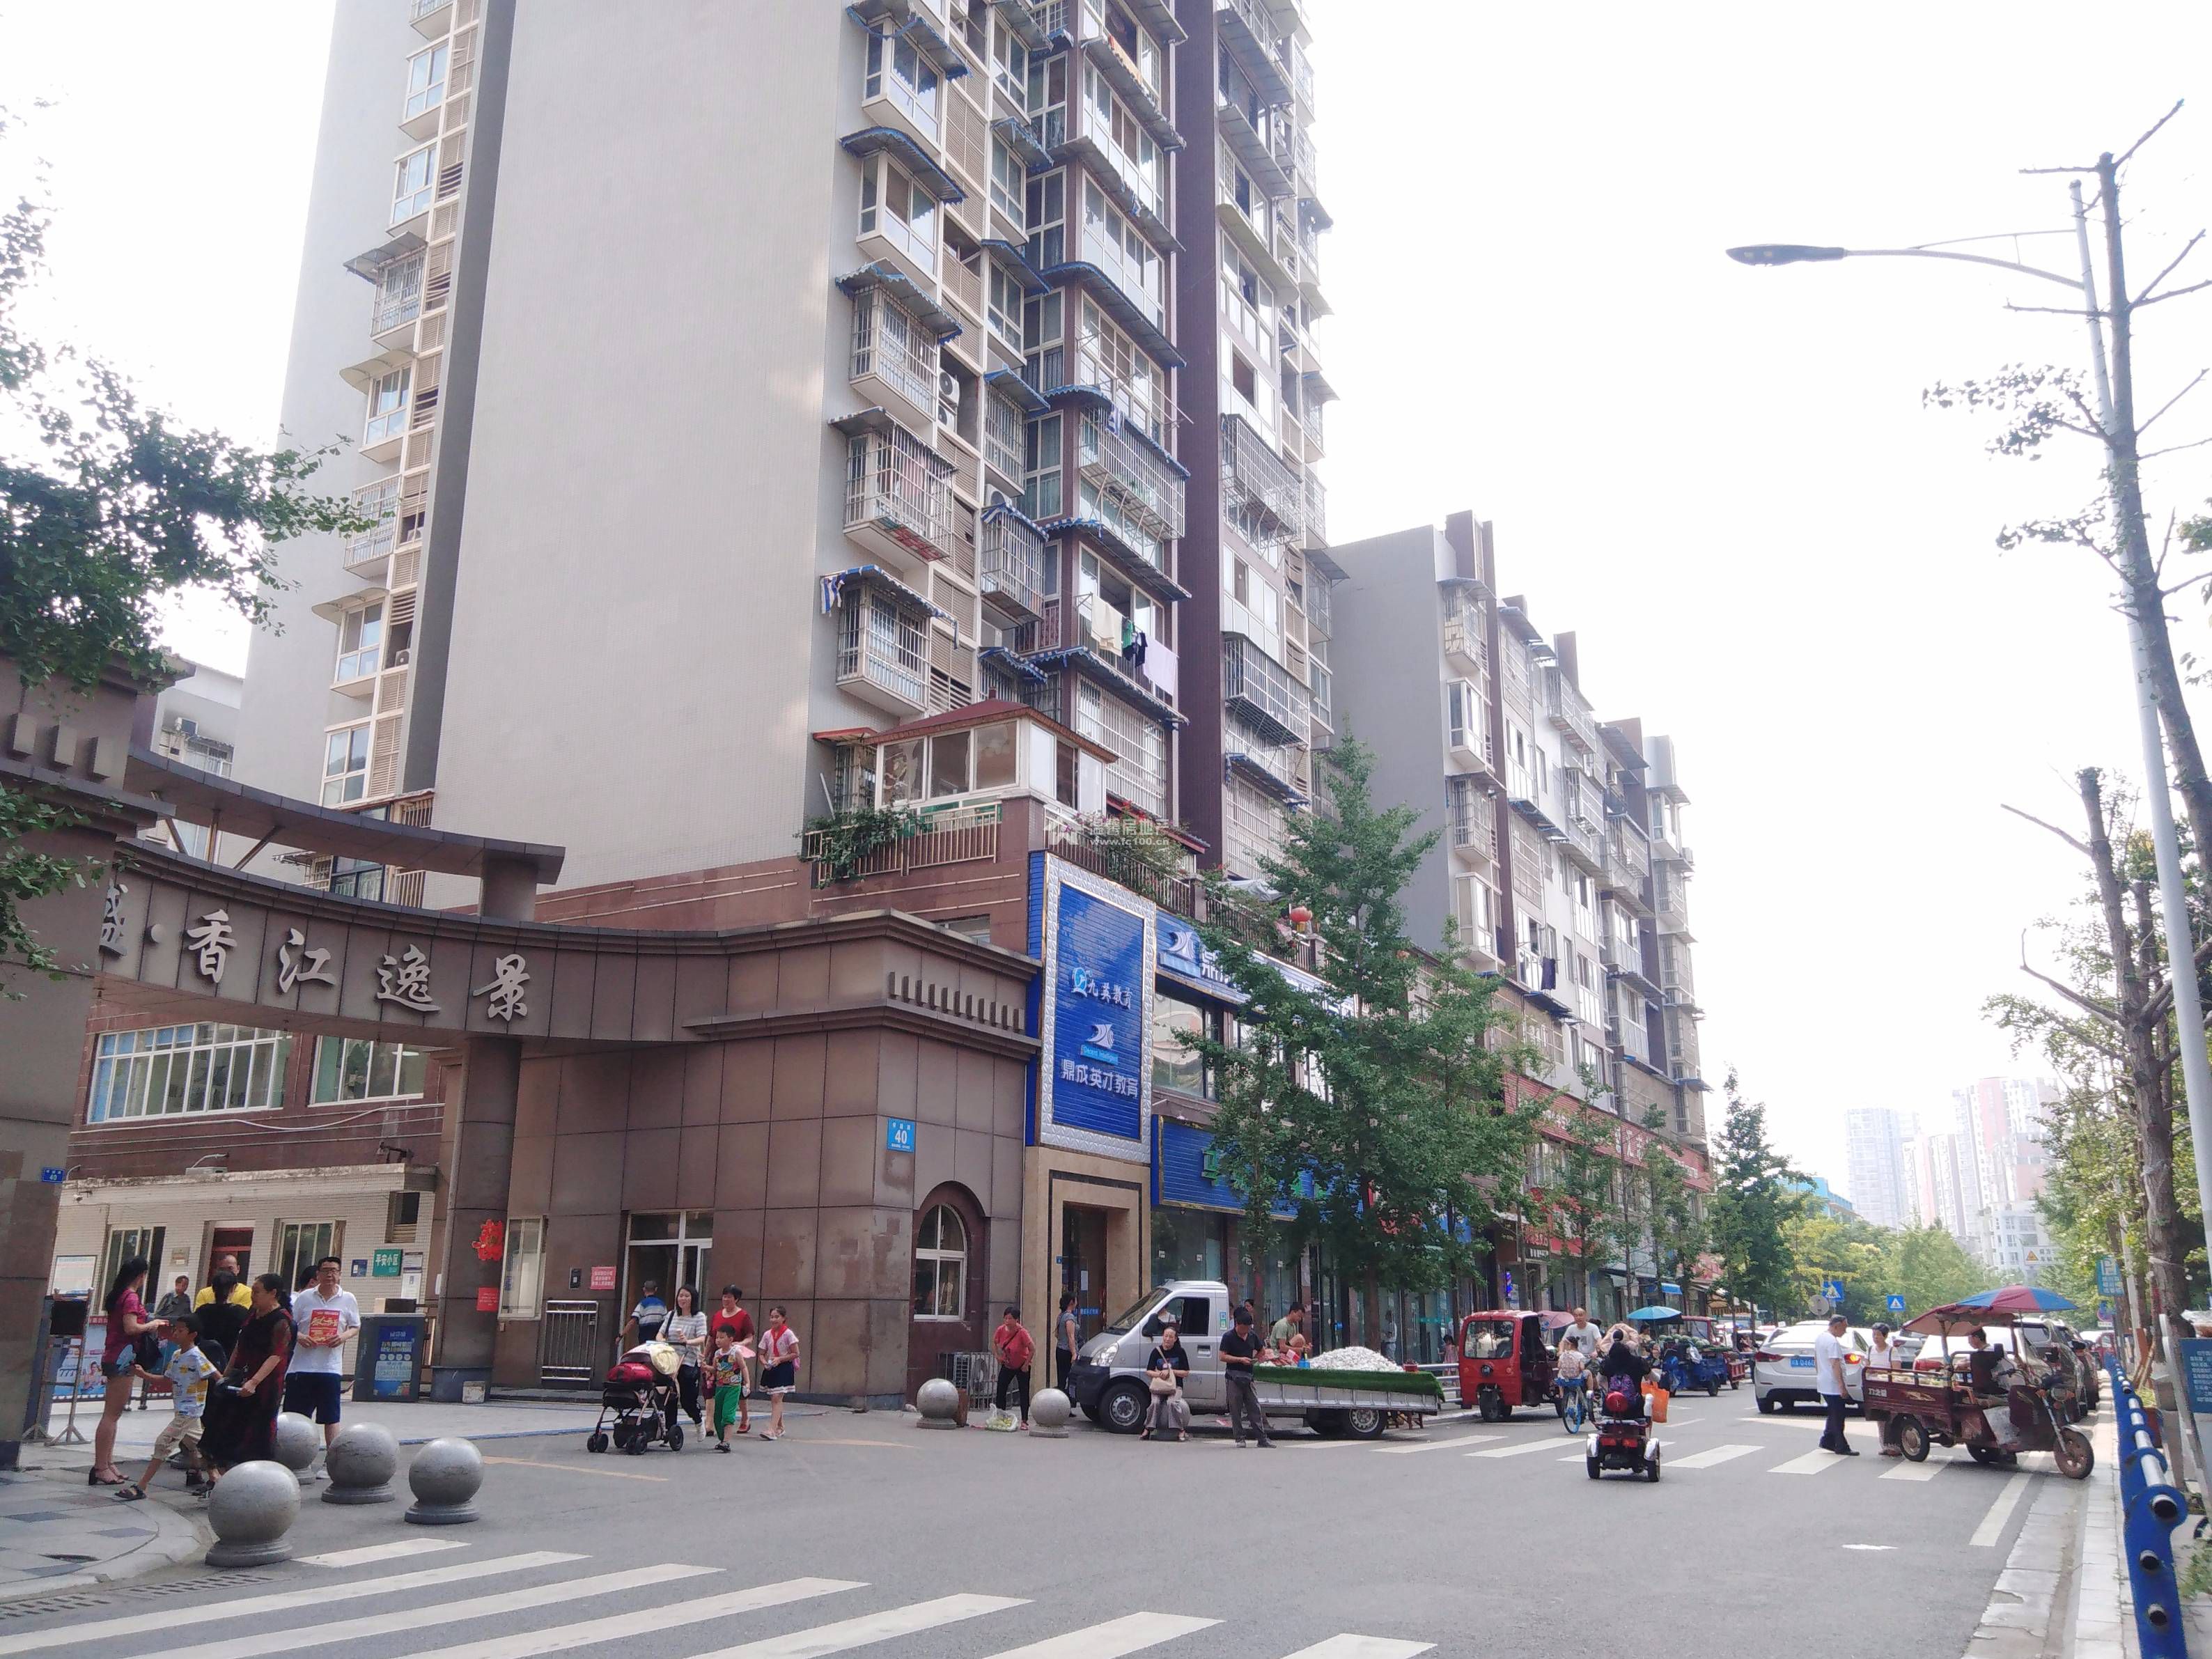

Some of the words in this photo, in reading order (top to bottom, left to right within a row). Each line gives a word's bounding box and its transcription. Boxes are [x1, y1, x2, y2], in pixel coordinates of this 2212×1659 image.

[1087, 979, 1132, 1009] 九英教育
[1061, 1059, 1138, 1098] 鼎成英才教育
[894, 1130, 908, 1144] 40
[375, 1254, 399, 1266] 平安小区
